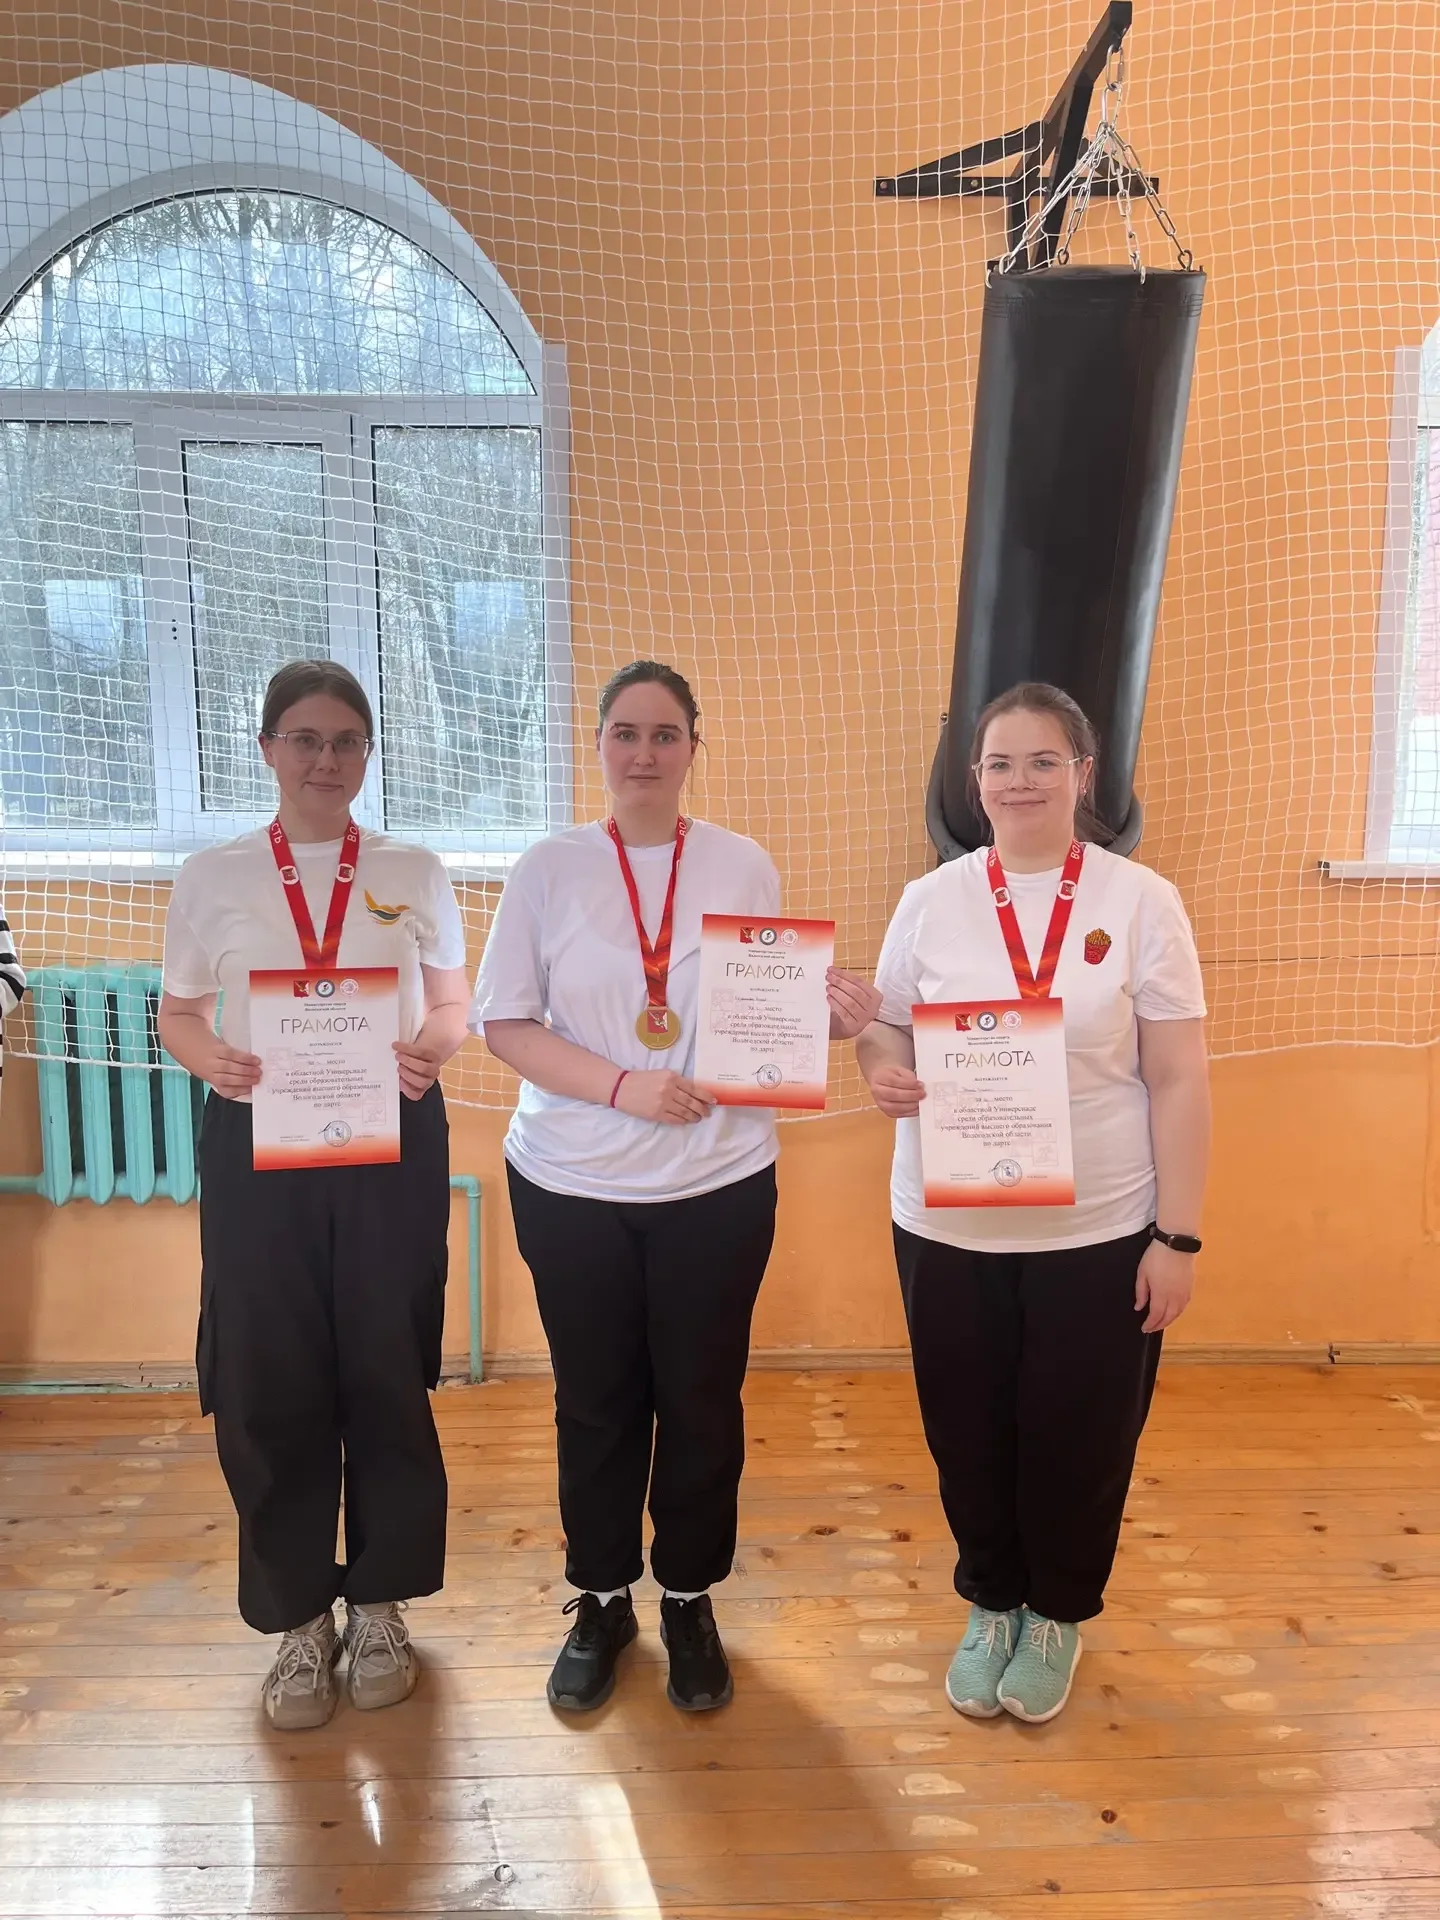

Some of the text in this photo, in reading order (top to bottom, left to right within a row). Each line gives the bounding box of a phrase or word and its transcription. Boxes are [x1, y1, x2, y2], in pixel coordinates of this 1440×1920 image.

[347, 824, 358, 843] ВО
[726, 962, 806, 980] ГРАМОТА
[732, 1013, 762, 1021] областной
[763, 1015, 801, 1023] Универсиаде
[280, 1016, 372, 1034] ГРАМОТА
[748, 1022, 797, 1031] образовательных
[714, 1028, 749, 1036] учреждений
[732, 1037, 794, 1046] Вологодской области
[945, 1050, 1036, 1069] ГРАМОТА
[291, 1069, 324, 1077] областной
[309, 1077, 364, 1085] образовательных
[342, 1083, 381, 1091] образования
[293, 1091, 361, 1101] Вологодской области
[959, 1106, 992, 1114] областной
[994, 1105, 1036, 1113] Универсиаде
[977, 1114, 1033, 1122] образовательных
[940, 1124, 980, 1132] учреждений
[1011, 1121, 1052, 1129] образования
[962, 1130, 1031, 1139] Вологодской области
